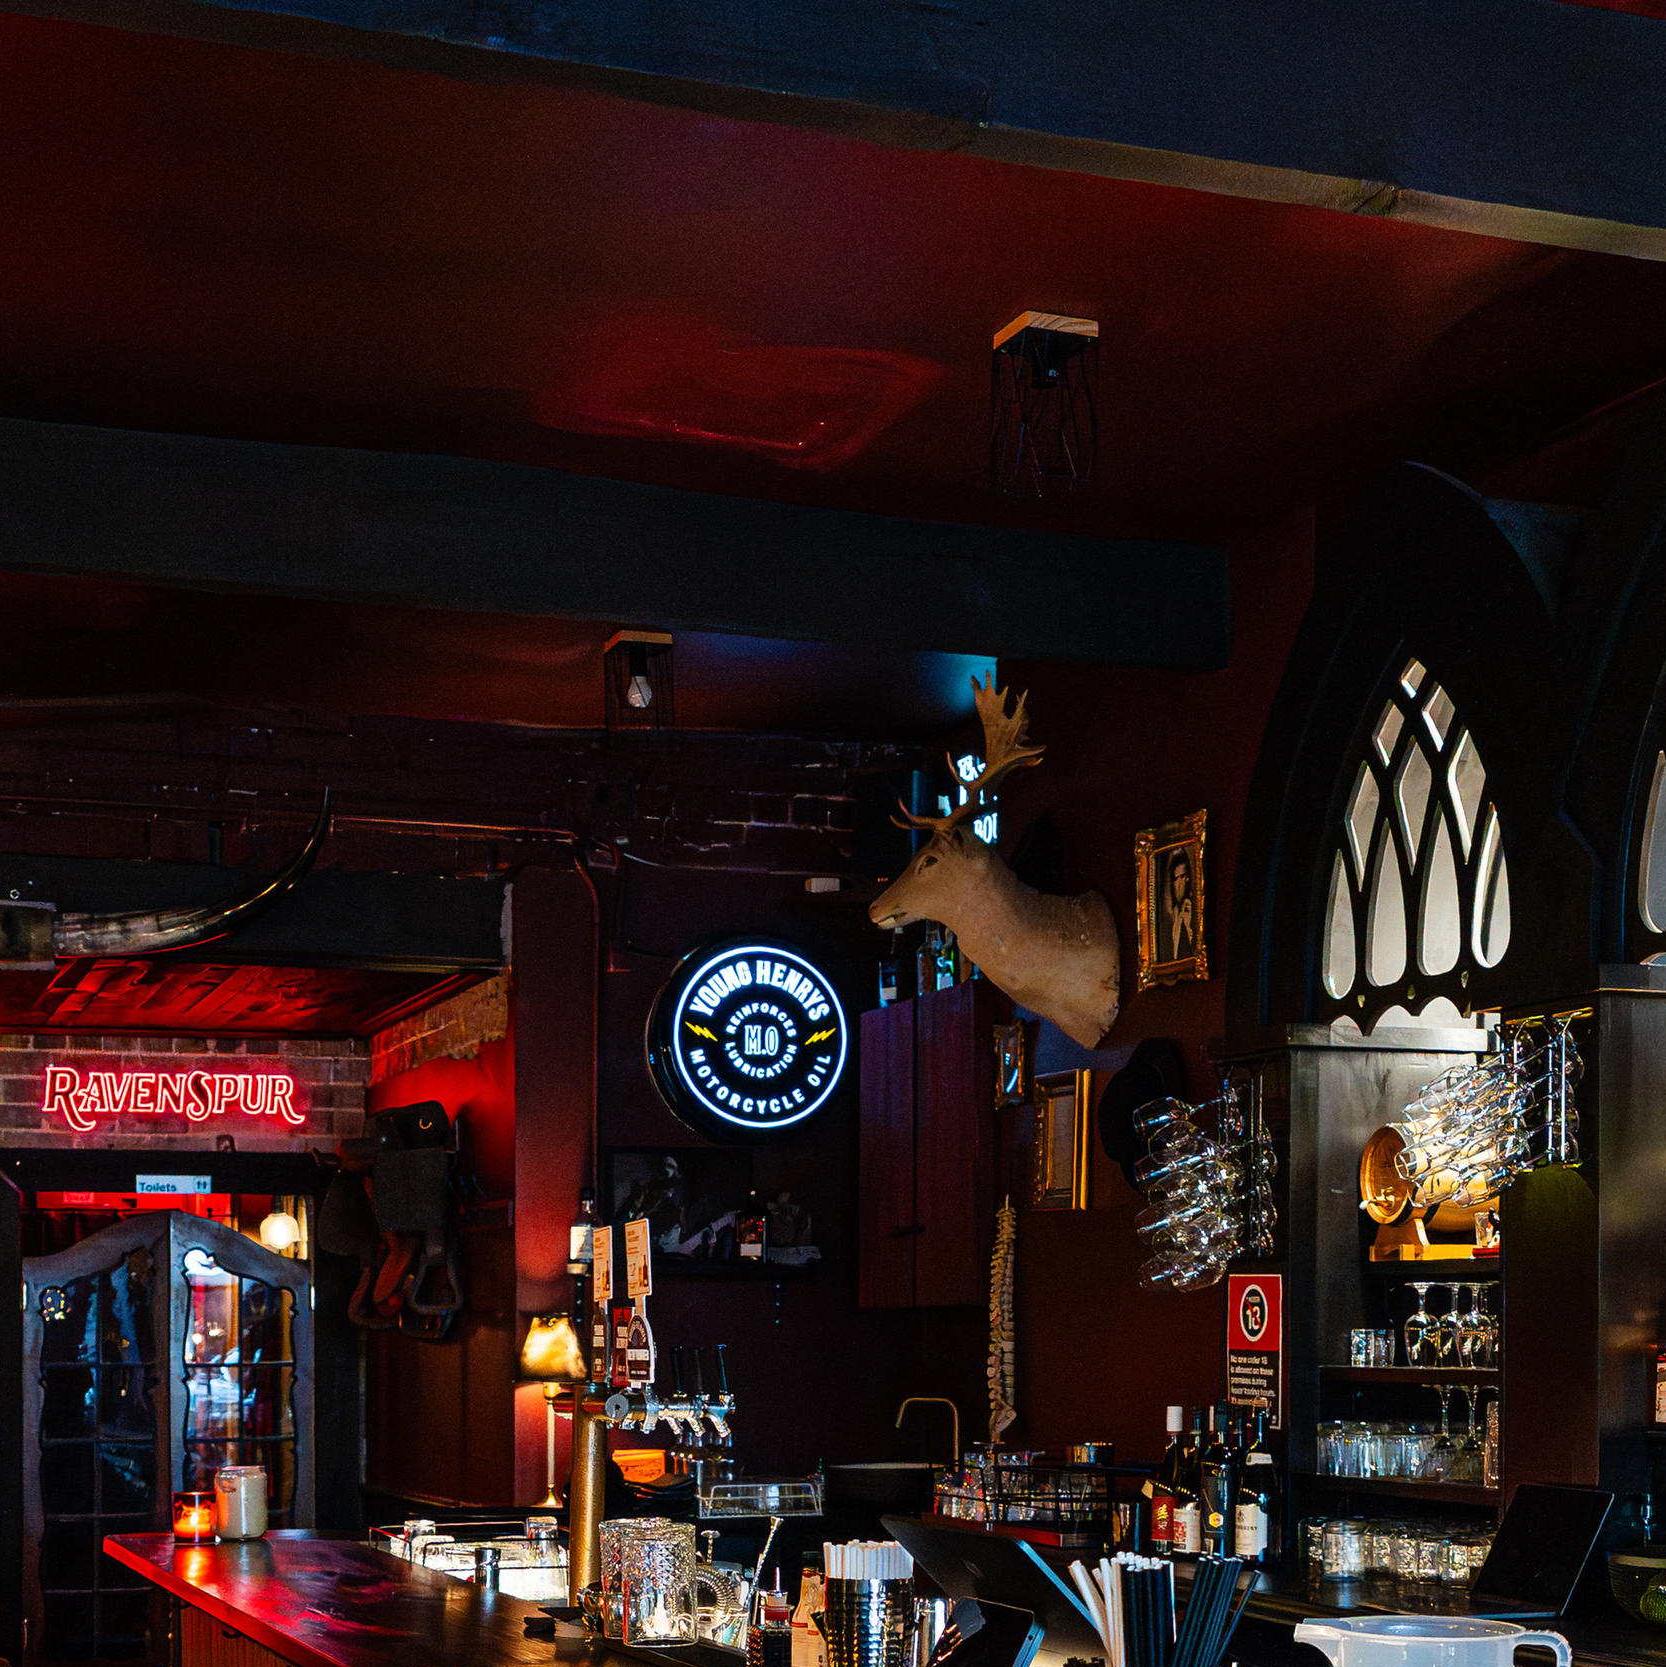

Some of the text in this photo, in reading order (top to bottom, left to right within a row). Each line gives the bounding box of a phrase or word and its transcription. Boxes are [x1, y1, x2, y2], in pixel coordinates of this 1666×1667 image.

[689, 960, 831, 1021] YOUNG HENRYS
[725, 1002, 797, 1038] REINFORCES
[744, 1025, 779, 1056] M.O
[724, 1041, 797, 1078] LUBRICATION
[690, 1048, 831, 1114] MOTORCYCLE OIL
[139, 1182, 177, 1193] Toilets
